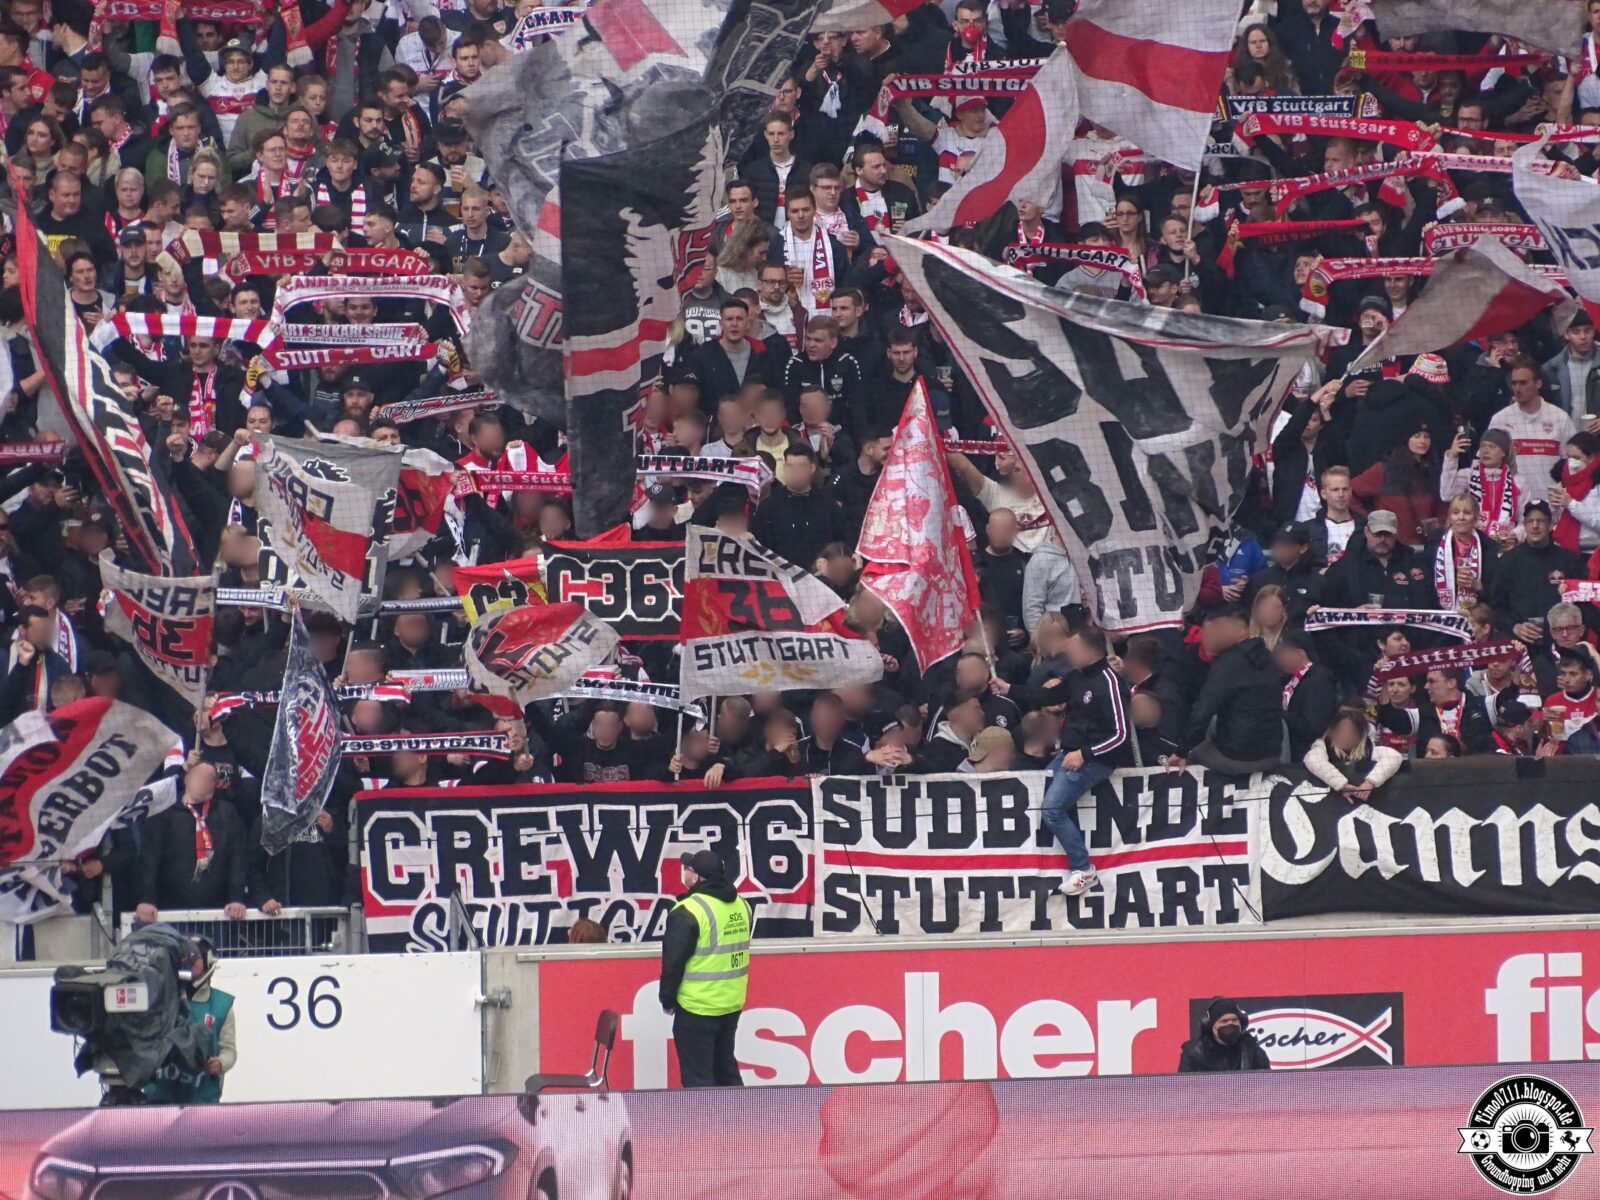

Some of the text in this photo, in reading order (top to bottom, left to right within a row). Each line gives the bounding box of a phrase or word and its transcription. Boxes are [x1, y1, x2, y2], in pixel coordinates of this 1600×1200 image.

[893, 78, 932, 91] VfB
[1233, 99, 1350, 114] VfB Stuttgart
[1270, 114, 1397, 136] VfB Stuttgart
[256, 253, 297, 268] VfB
[1020, 245, 1130, 268] STUTTGART
[279, 344, 421, 367] STUTT GART
[481, 474, 571, 484] VfB Stutt
[694, 636, 850, 671] STUTTGART
[1379, 644, 1514, 673] Stuttgar
[380, 736, 506, 751] STUTTGART
[820, 770, 1250, 849] SÜDBNDE
[730, 951, 744, 969] 0677
[266, 976, 343, 1031] 36
[1485, 952, 1600, 1063] fi
[621, 971, 1158, 1090] fscher
